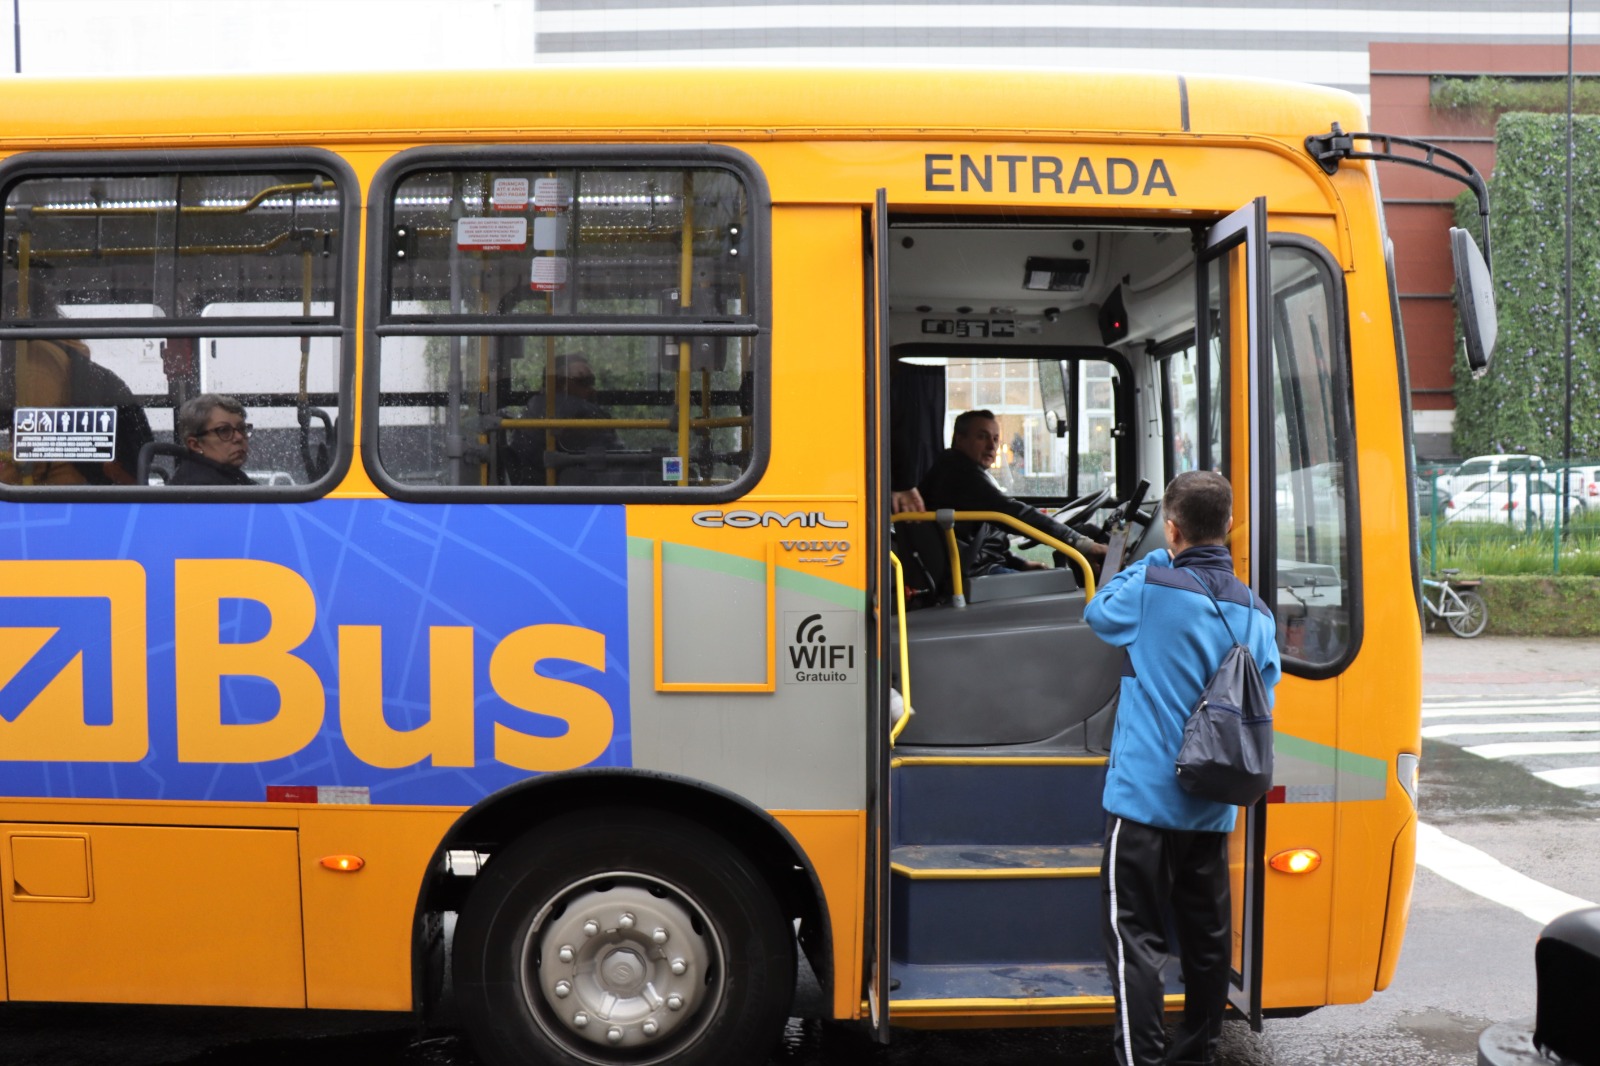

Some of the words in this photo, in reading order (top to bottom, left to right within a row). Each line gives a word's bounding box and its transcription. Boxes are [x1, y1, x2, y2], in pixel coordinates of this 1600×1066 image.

[925, 153, 1177, 197] ENTRADA
[692, 510, 848, 529] COMIL
[780, 540, 850, 551] VOLVO
[175, 558, 615, 772] Bus
[796, 671, 847, 682] Gratuito
